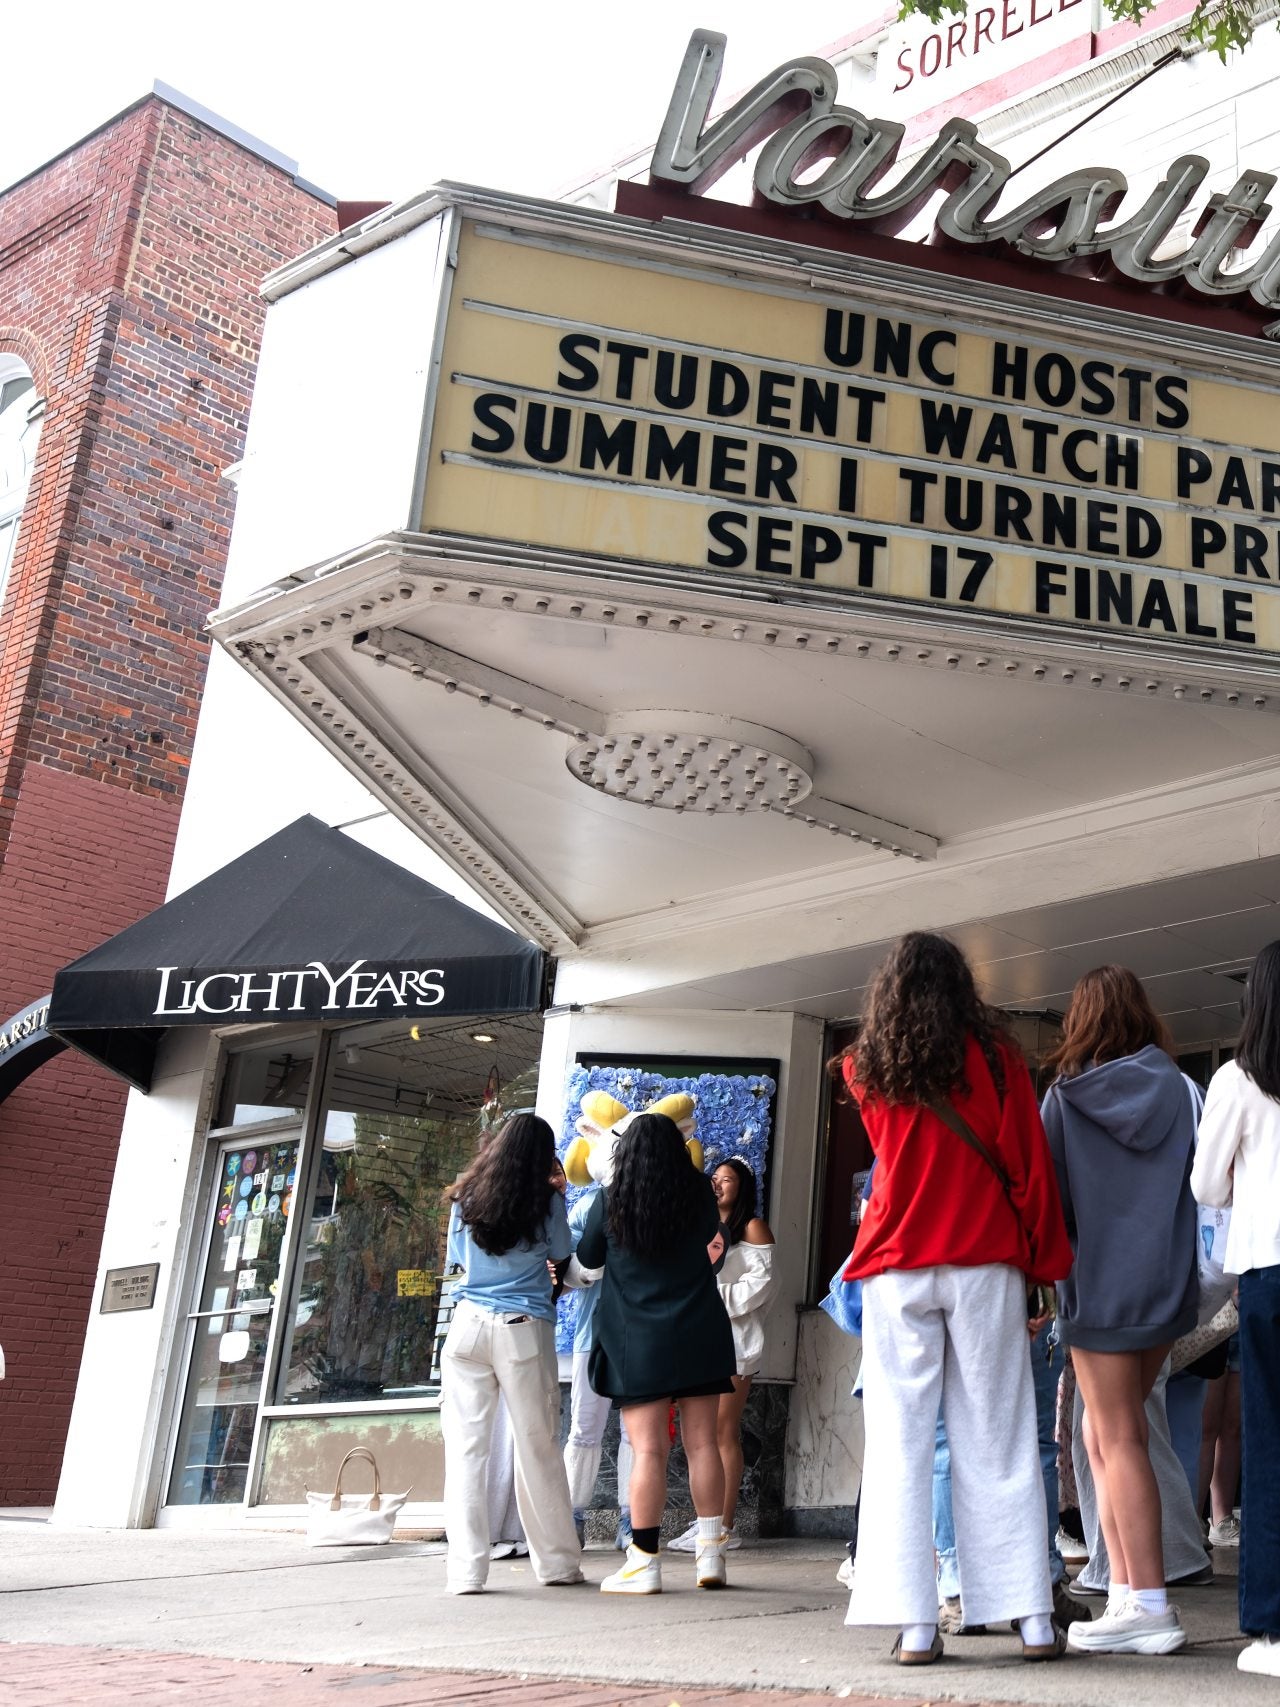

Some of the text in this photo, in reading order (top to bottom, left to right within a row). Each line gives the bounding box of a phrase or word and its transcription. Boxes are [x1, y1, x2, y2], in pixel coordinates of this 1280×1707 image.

[892, 0, 1083, 94] SORREL
[558, 334, 886, 443] STUDENT
[920, 399, 1139, 490] WATCH
[824, 308, 1190, 429] UNC HOSTS
[472, 394, 798, 504] SUMMER
[839, 458, 858, 513] I
[900, 468, 1162, 558] TURNED
[707, 511, 887, 587] SEPT
[930, 545, 994, 602] 17
[1035, 561, 1256, 644] FINALE
